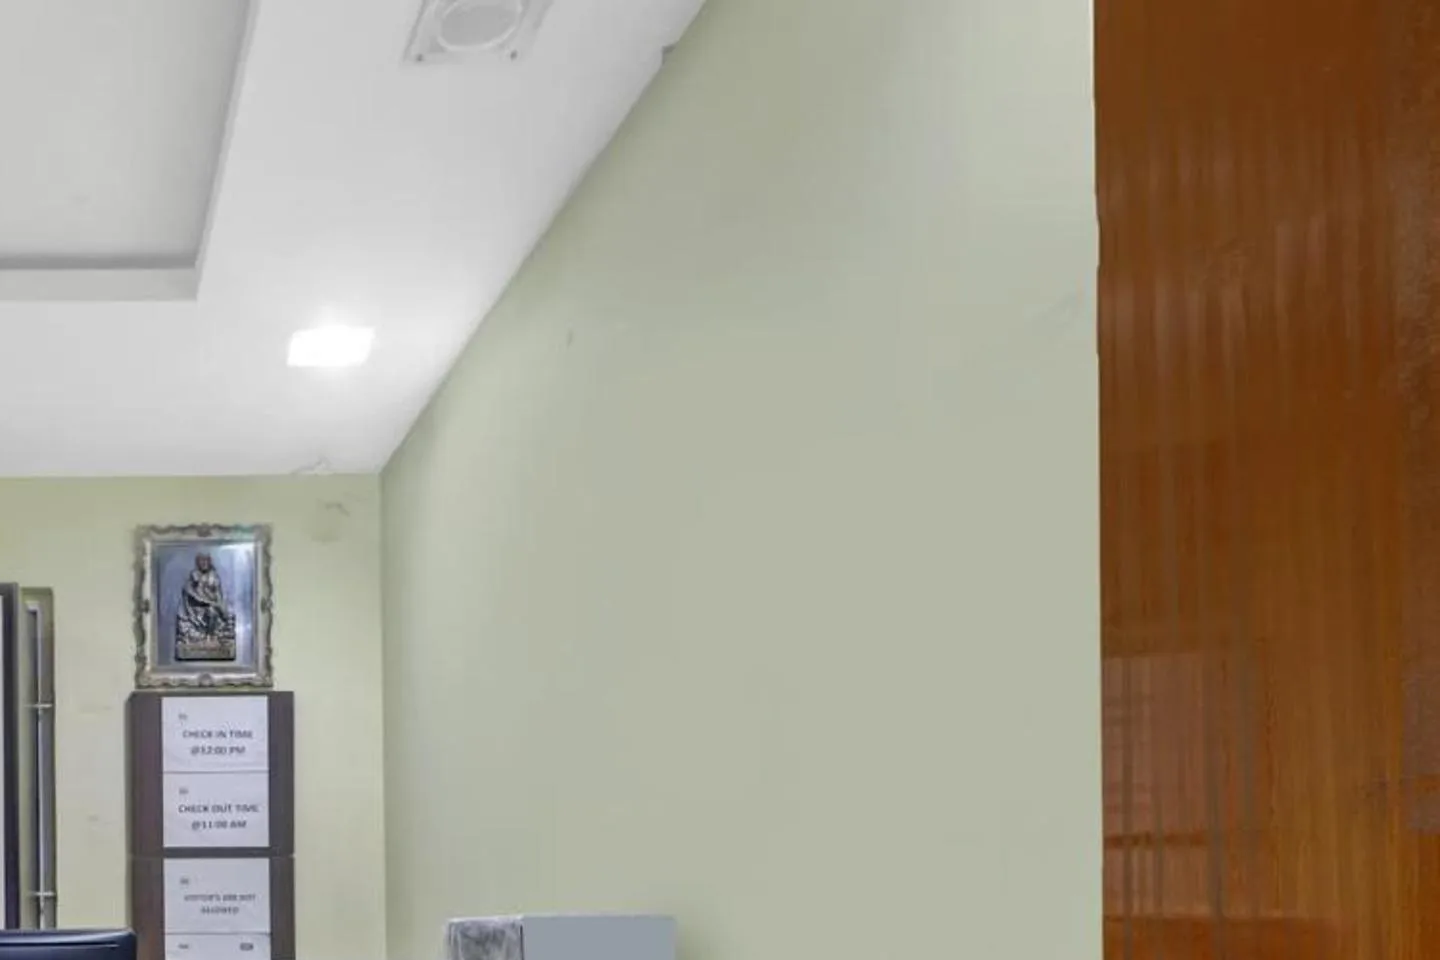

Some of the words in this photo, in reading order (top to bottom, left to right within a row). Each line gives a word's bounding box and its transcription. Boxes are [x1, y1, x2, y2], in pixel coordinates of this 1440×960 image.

[182, 729, 213, 739] CHECK
[215, 730, 227, 739] IN
[229, 729, 253, 739] TIME
[229, 746, 246, 755] PM
[178, 804, 209, 814] CHECK
[211, 804, 232, 813] OUT
[235, 804, 259, 813] TIME
[230, 820, 247, 829] AM
